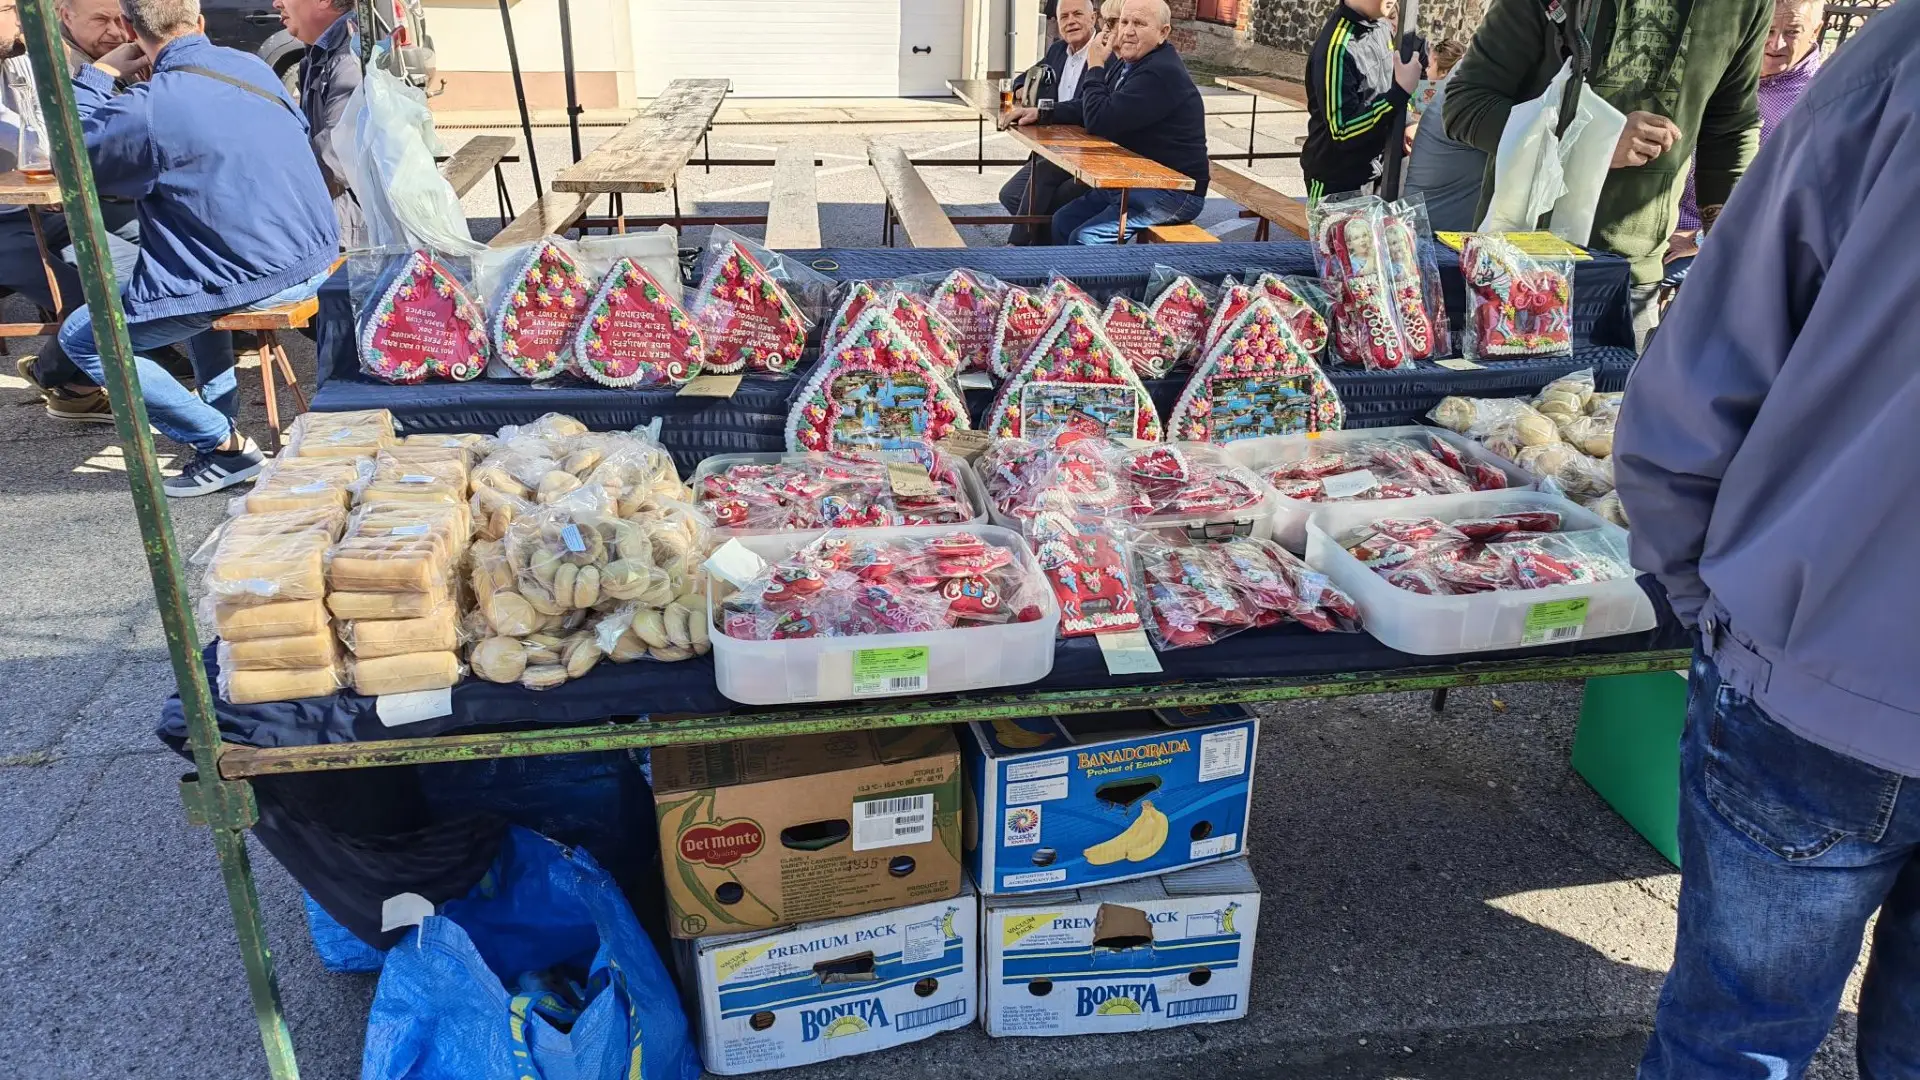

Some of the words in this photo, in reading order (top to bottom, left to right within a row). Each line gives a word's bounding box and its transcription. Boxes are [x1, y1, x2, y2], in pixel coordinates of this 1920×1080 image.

[424, 335, 441, 345] PERE
[1077, 738, 1190, 770] BANADORADA
[1086, 766, 1123, 778] Product
[1124, 762, 1134, 773] of
[1136, 756, 1173, 770] Ecuador
[684, 839, 710, 855] Del
[712, 831, 759, 850] Monte
[1006, 916, 1036, 936] VACUUM
[1015, 923, 1035, 937] PACK
[1052, 918, 1098, 930] PREM
[1147, 911, 1180, 924] ACK
[767, 934, 850, 960] PREMIUM
[856, 924, 897, 942] PACK
[1076, 983, 1162, 1018] BONITA
[800, 997, 890, 1042] BONITA
